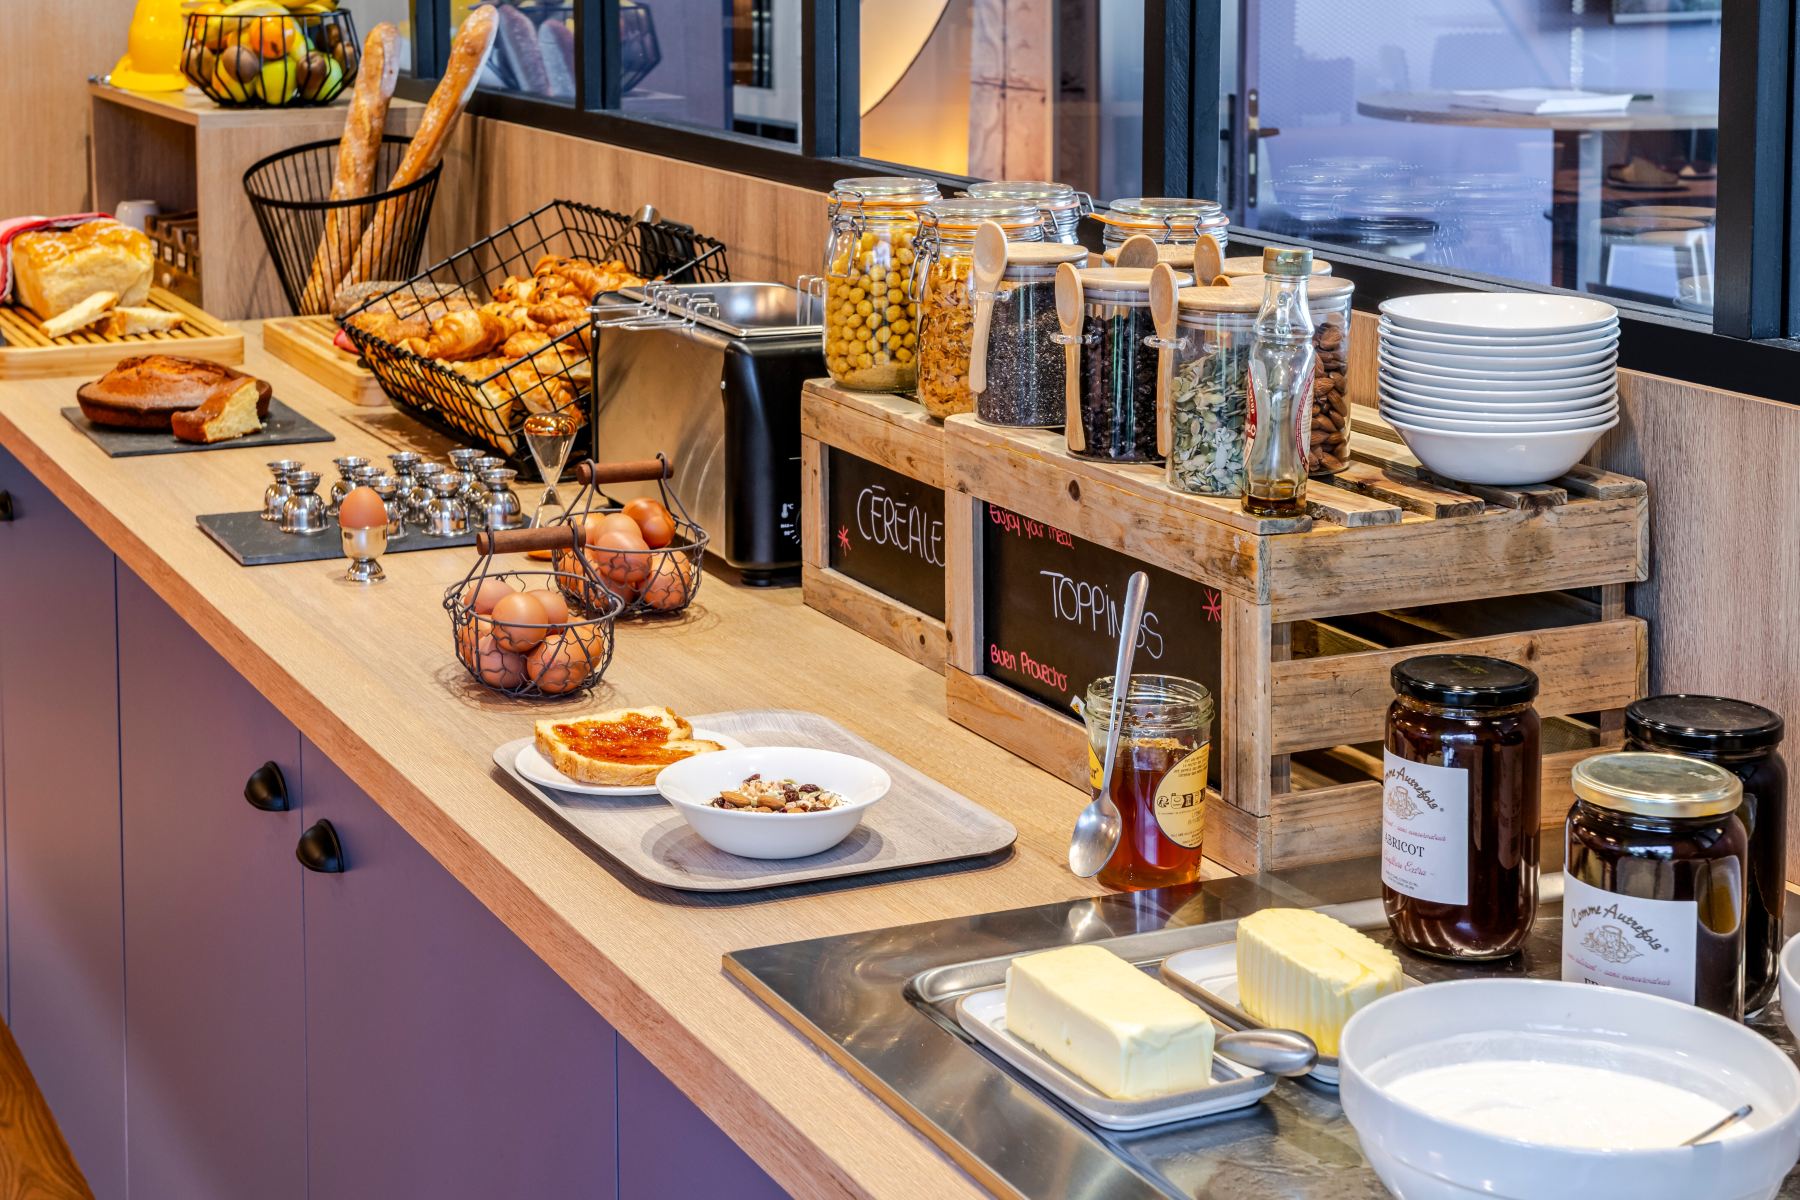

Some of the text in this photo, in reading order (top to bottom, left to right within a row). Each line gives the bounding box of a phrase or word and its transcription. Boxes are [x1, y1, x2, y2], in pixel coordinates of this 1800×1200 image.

[1023, 517, 1044, 540] your
[991, 644, 1067, 692] Buen Provecho
